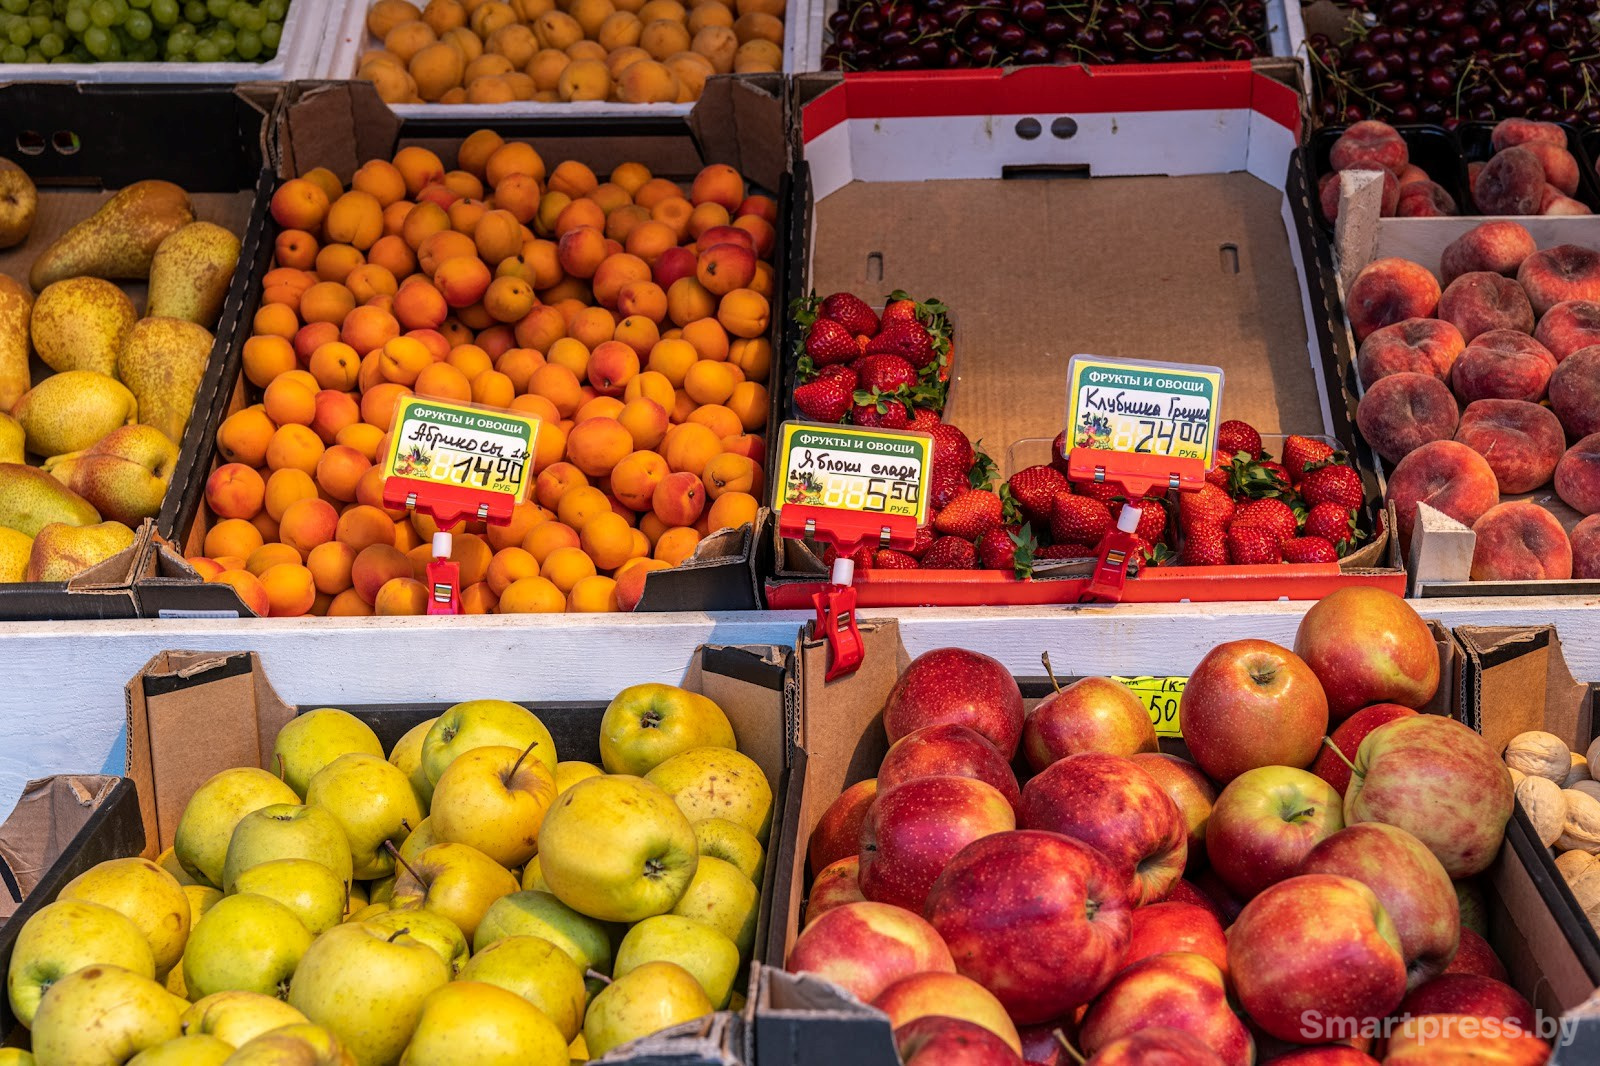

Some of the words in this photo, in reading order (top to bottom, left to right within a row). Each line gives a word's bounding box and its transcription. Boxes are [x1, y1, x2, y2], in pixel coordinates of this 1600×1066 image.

[1089, 371, 1141, 386] ФРУКТЫ
[1143, 377, 1153, 387] И
[1155, 378, 1204, 393] ОВОЩИ
[1085, 388, 1161, 416] Клубника
[414, 407, 463, 424] ФРУКТЫ
[465, 415, 475, 425] И
[477, 418, 523, 435] ОВОЩИ
[799, 433, 851, 448] ФРУКТЫ
[854, 439, 863, 449] И
[866, 441, 915, 454] ОВОЩИ
[492, 483, 512, 493] РУБ.
[889, 505, 911, 514] РУБ.
